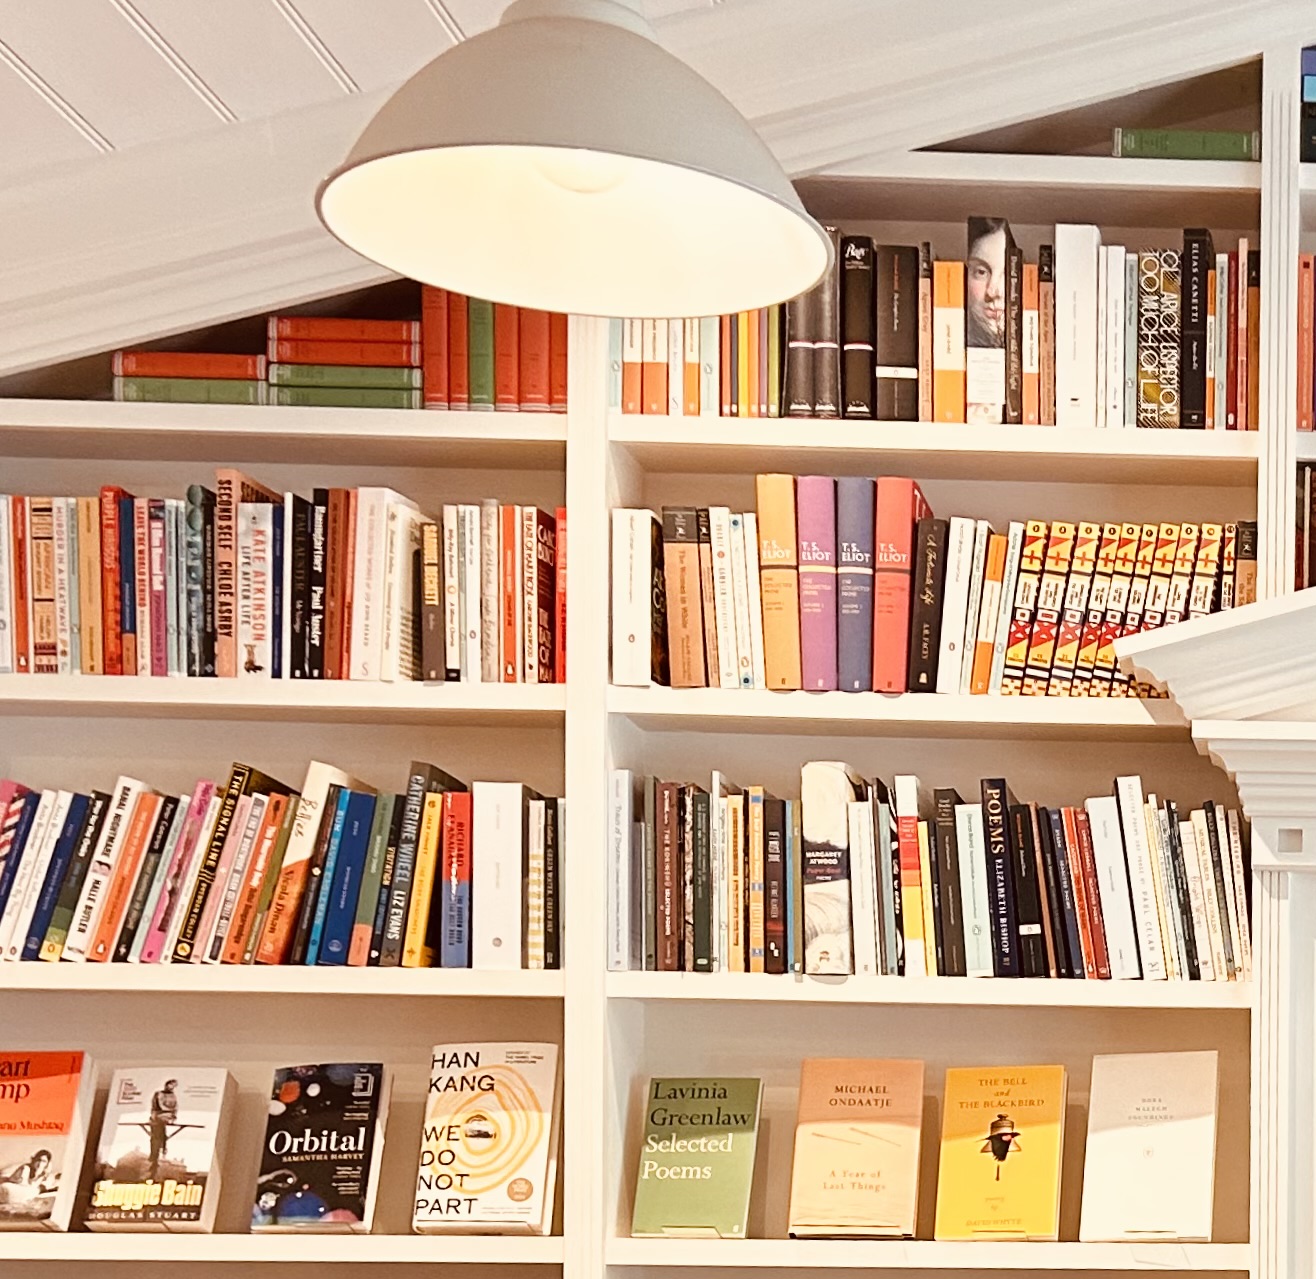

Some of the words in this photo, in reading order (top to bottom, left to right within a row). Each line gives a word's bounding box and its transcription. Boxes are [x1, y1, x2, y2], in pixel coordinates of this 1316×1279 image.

[219, 480, 232, 522] SECOND
[219, 524, 232, 549] SELF
[252, 530, 267, 564] KATE
[802, 552, 831, 561] ELIOT
[842, 553, 871, 562] ELIOT
[219, 562, 232, 596] CHLOE
[253, 571, 267, 642] ATKINSON
[218, 600, 232, 638] ASHBY
[400, 775, 425, 845] CATHERINE
[986, 789, 1005, 854] POEMS
[397, 844, 415, 883] WHEEL
[995, 859, 1009, 912] ELIZABETH
[393, 890, 406, 908] LIZ
[387, 907, 404, 940] EVANS
[1000, 915, 1009, 954] BISHOP
[432, 1052, 480, 1069] HAN
[429, 1075, 495, 1093] KANG
[653, 1082, 728, 1100] Lavinia
[834, 1085, 889, 1094] MICHAEL
[829, 1098, 892, 1107] ONDAATJE
[650, 1108, 752, 1126] Greenlaw
[269, 1127, 366, 1155] Orbital
[424, 1125, 460, 1142] WE
[646, 1133, 733, 1152] Selected
[421, 1150, 455, 1166] DO
[642, 1161, 712, 1180] Poems
[418, 1174, 470, 1191] NOT
[415, 1198, 478, 1215] PART
